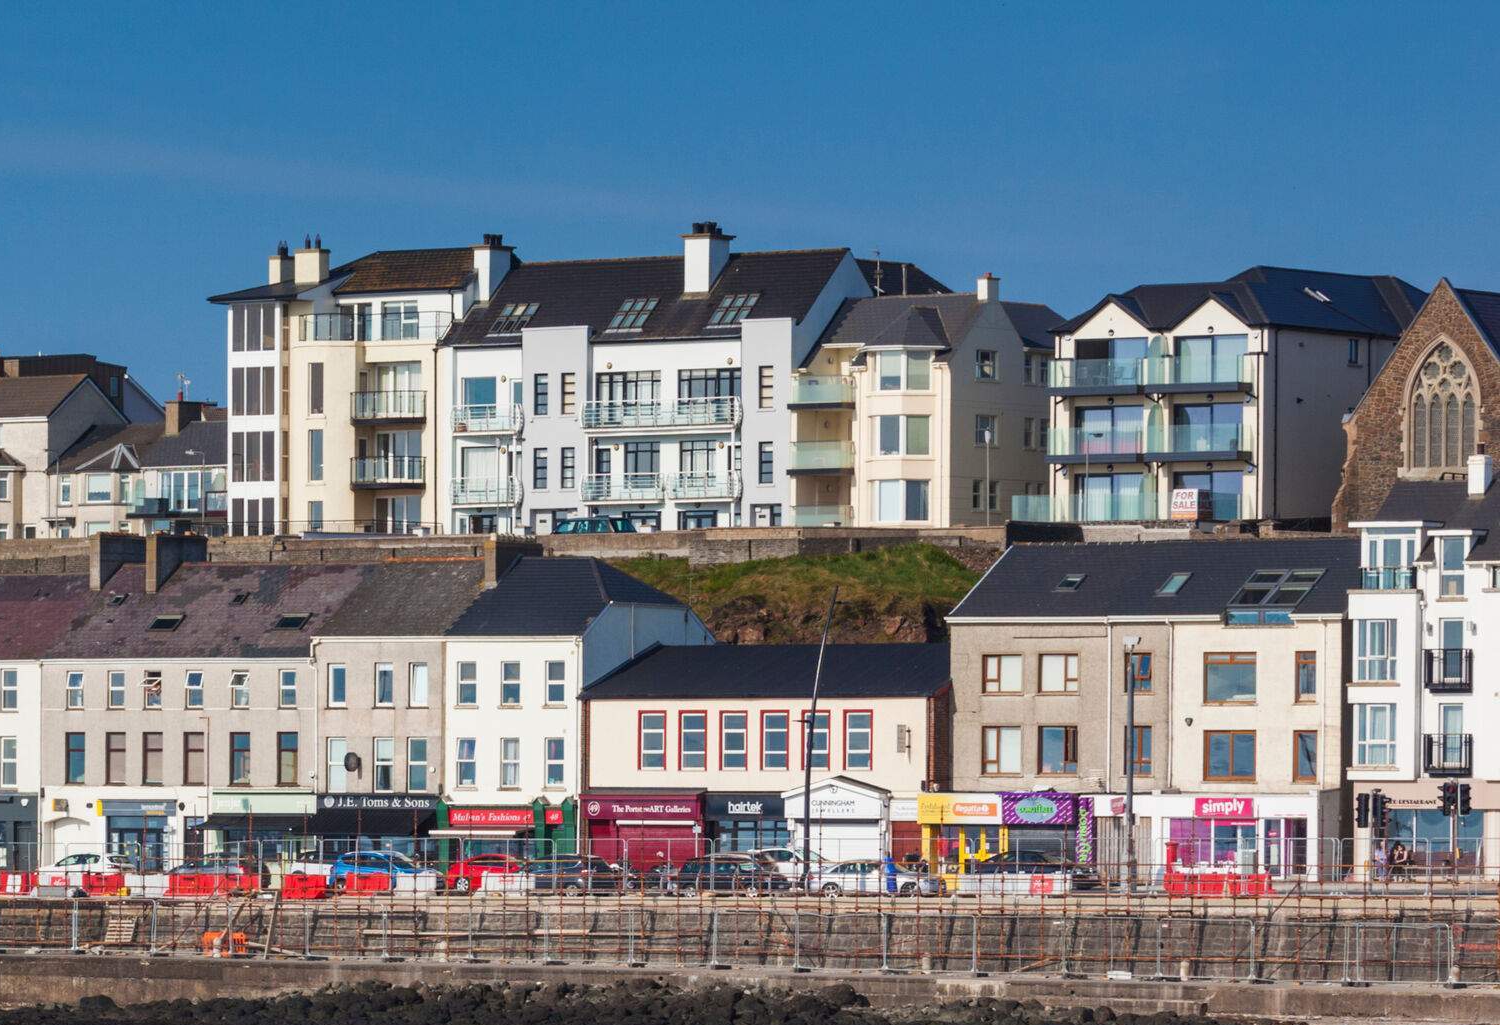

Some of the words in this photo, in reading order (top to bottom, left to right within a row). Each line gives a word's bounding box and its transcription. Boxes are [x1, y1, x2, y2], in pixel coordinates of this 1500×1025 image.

[1174, 491, 1194, 500] FOR
[1172, 501, 1197, 510] SALE
[337, 797, 358, 807] J.E.
[361, 797, 389, 808] Toms
[391, 797, 402, 808] &
[404, 797, 430, 808] Sons
[612, 804, 622, 813] The
[665, 805, 692, 813] Galleries
[728, 801, 763, 814] hairtek
[1202, 799, 1245, 816] simply
[488, 812, 521, 821] Fashions
